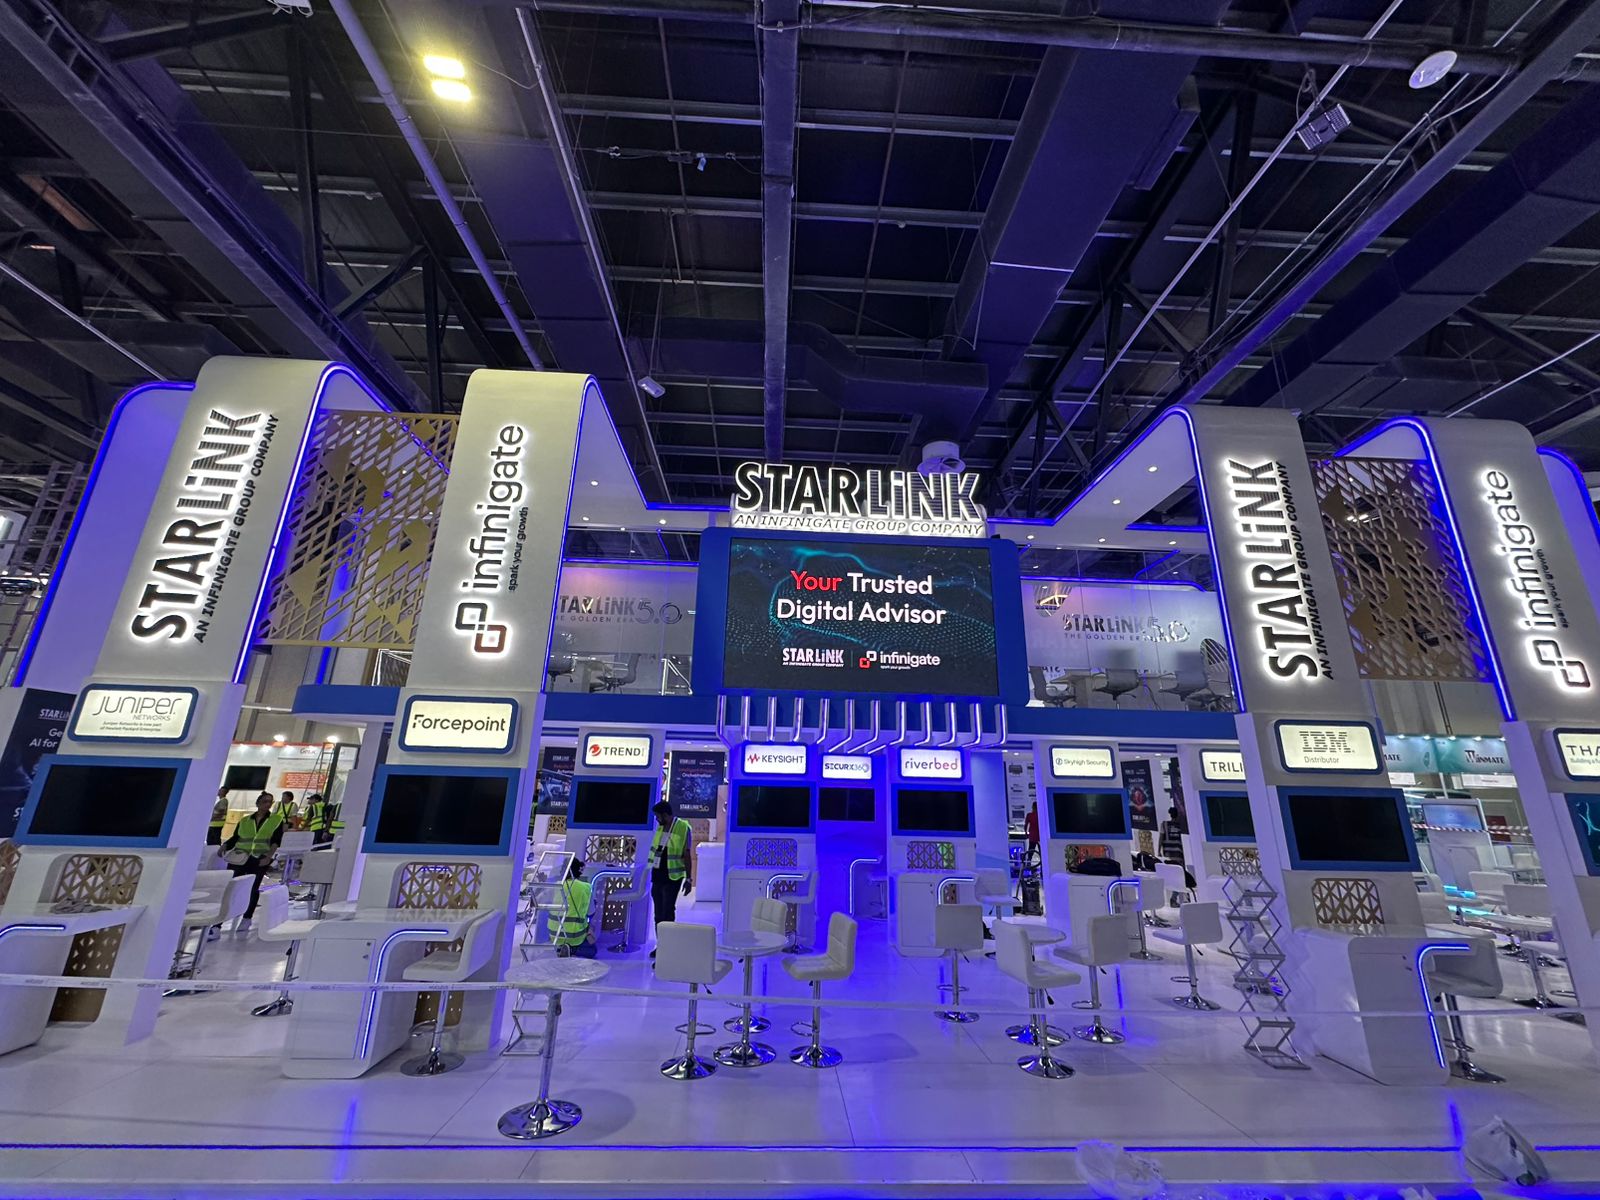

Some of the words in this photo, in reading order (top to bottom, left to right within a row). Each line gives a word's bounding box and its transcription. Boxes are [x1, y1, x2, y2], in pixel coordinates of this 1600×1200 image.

[250, 414, 279, 477] COMPANY
[233, 479, 256, 527] GROUP
[1276, 461, 1298, 521] COMPANY
[462, 424, 524, 589] infinigate
[516, 506, 529, 542] growth
[734, 514, 757, 526] AN
[759, 515, 850, 530] INFINIGATE
[855, 519, 906, 532] GROUP
[911, 522, 984, 536] COMPANY
[512, 542, 523, 563] your
[1290, 524, 1309, 569] GROUP
[1486, 470, 1557, 629] infinigate
[201, 529, 241, 617] INFINIGATE
[508, 564, 521, 591] spark
[790, 570, 843, 591] Your
[847, 572, 933, 595] Trusted
[777, 598, 853, 625] Digital
[858, 602, 947, 625] Advisor
[1300, 572, 1329, 656] INFINIGATE
[193, 619, 210, 643] AN
[880, 651, 941, 668] infinigate
[1318, 658, 1334, 680] AN
[412, 713, 506, 734] Forcepoint
[29, 738, 42, 747] AI
[42, 738, 58, 748] for
[602, 746, 641, 756] TREND
[1299, 731, 1352, 753] IBM
[761, 755, 804, 764] KEYSIGHT
[904, 757, 958, 771] riverbed
[1209, 761, 1243, 773] TRILI
[1304, 756, 1340, 764] Distributor
